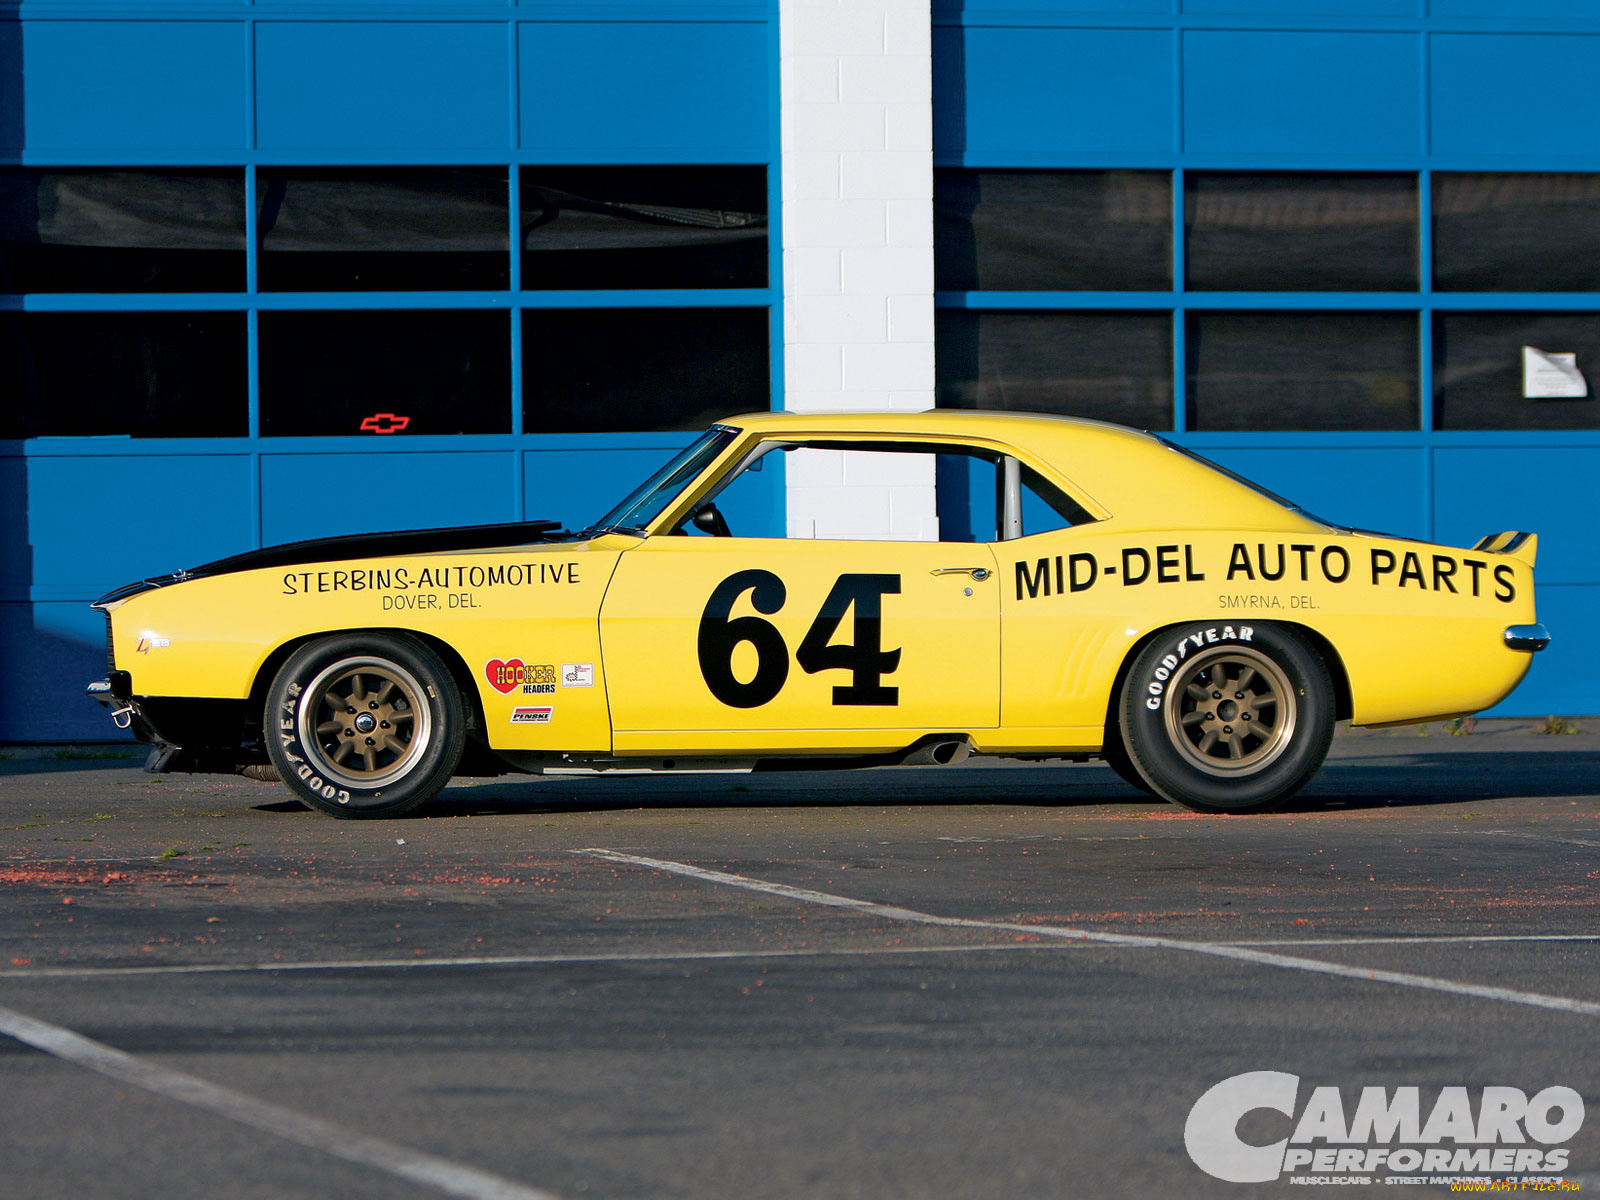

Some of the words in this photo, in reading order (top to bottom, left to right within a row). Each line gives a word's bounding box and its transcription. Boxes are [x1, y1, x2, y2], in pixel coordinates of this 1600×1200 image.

[282, 562, 581, 595] STERBINS-AUTOMOTIVE
[1015, 544, 1206, 600] MID-DEL
[1226, 543, 1351, 583] AUTO
[1371, 548, 1516, 603] PARTS
[382, 594, 442, 611] DOVER,
[448, 593, 482, 608] DEL.
[1218, 595, 1286, 611] SMYRNA,
[1290, 596, 1321, 609] DEL.
[697, 568, 902, 709] 64
[496, 664, 556, 685] HOOKER
[1146, 625, 1255, 710] GOODYEAR
[523, 684, 556, 694] HEADERS
[280, 682, 351, 804] GOODYEAR
